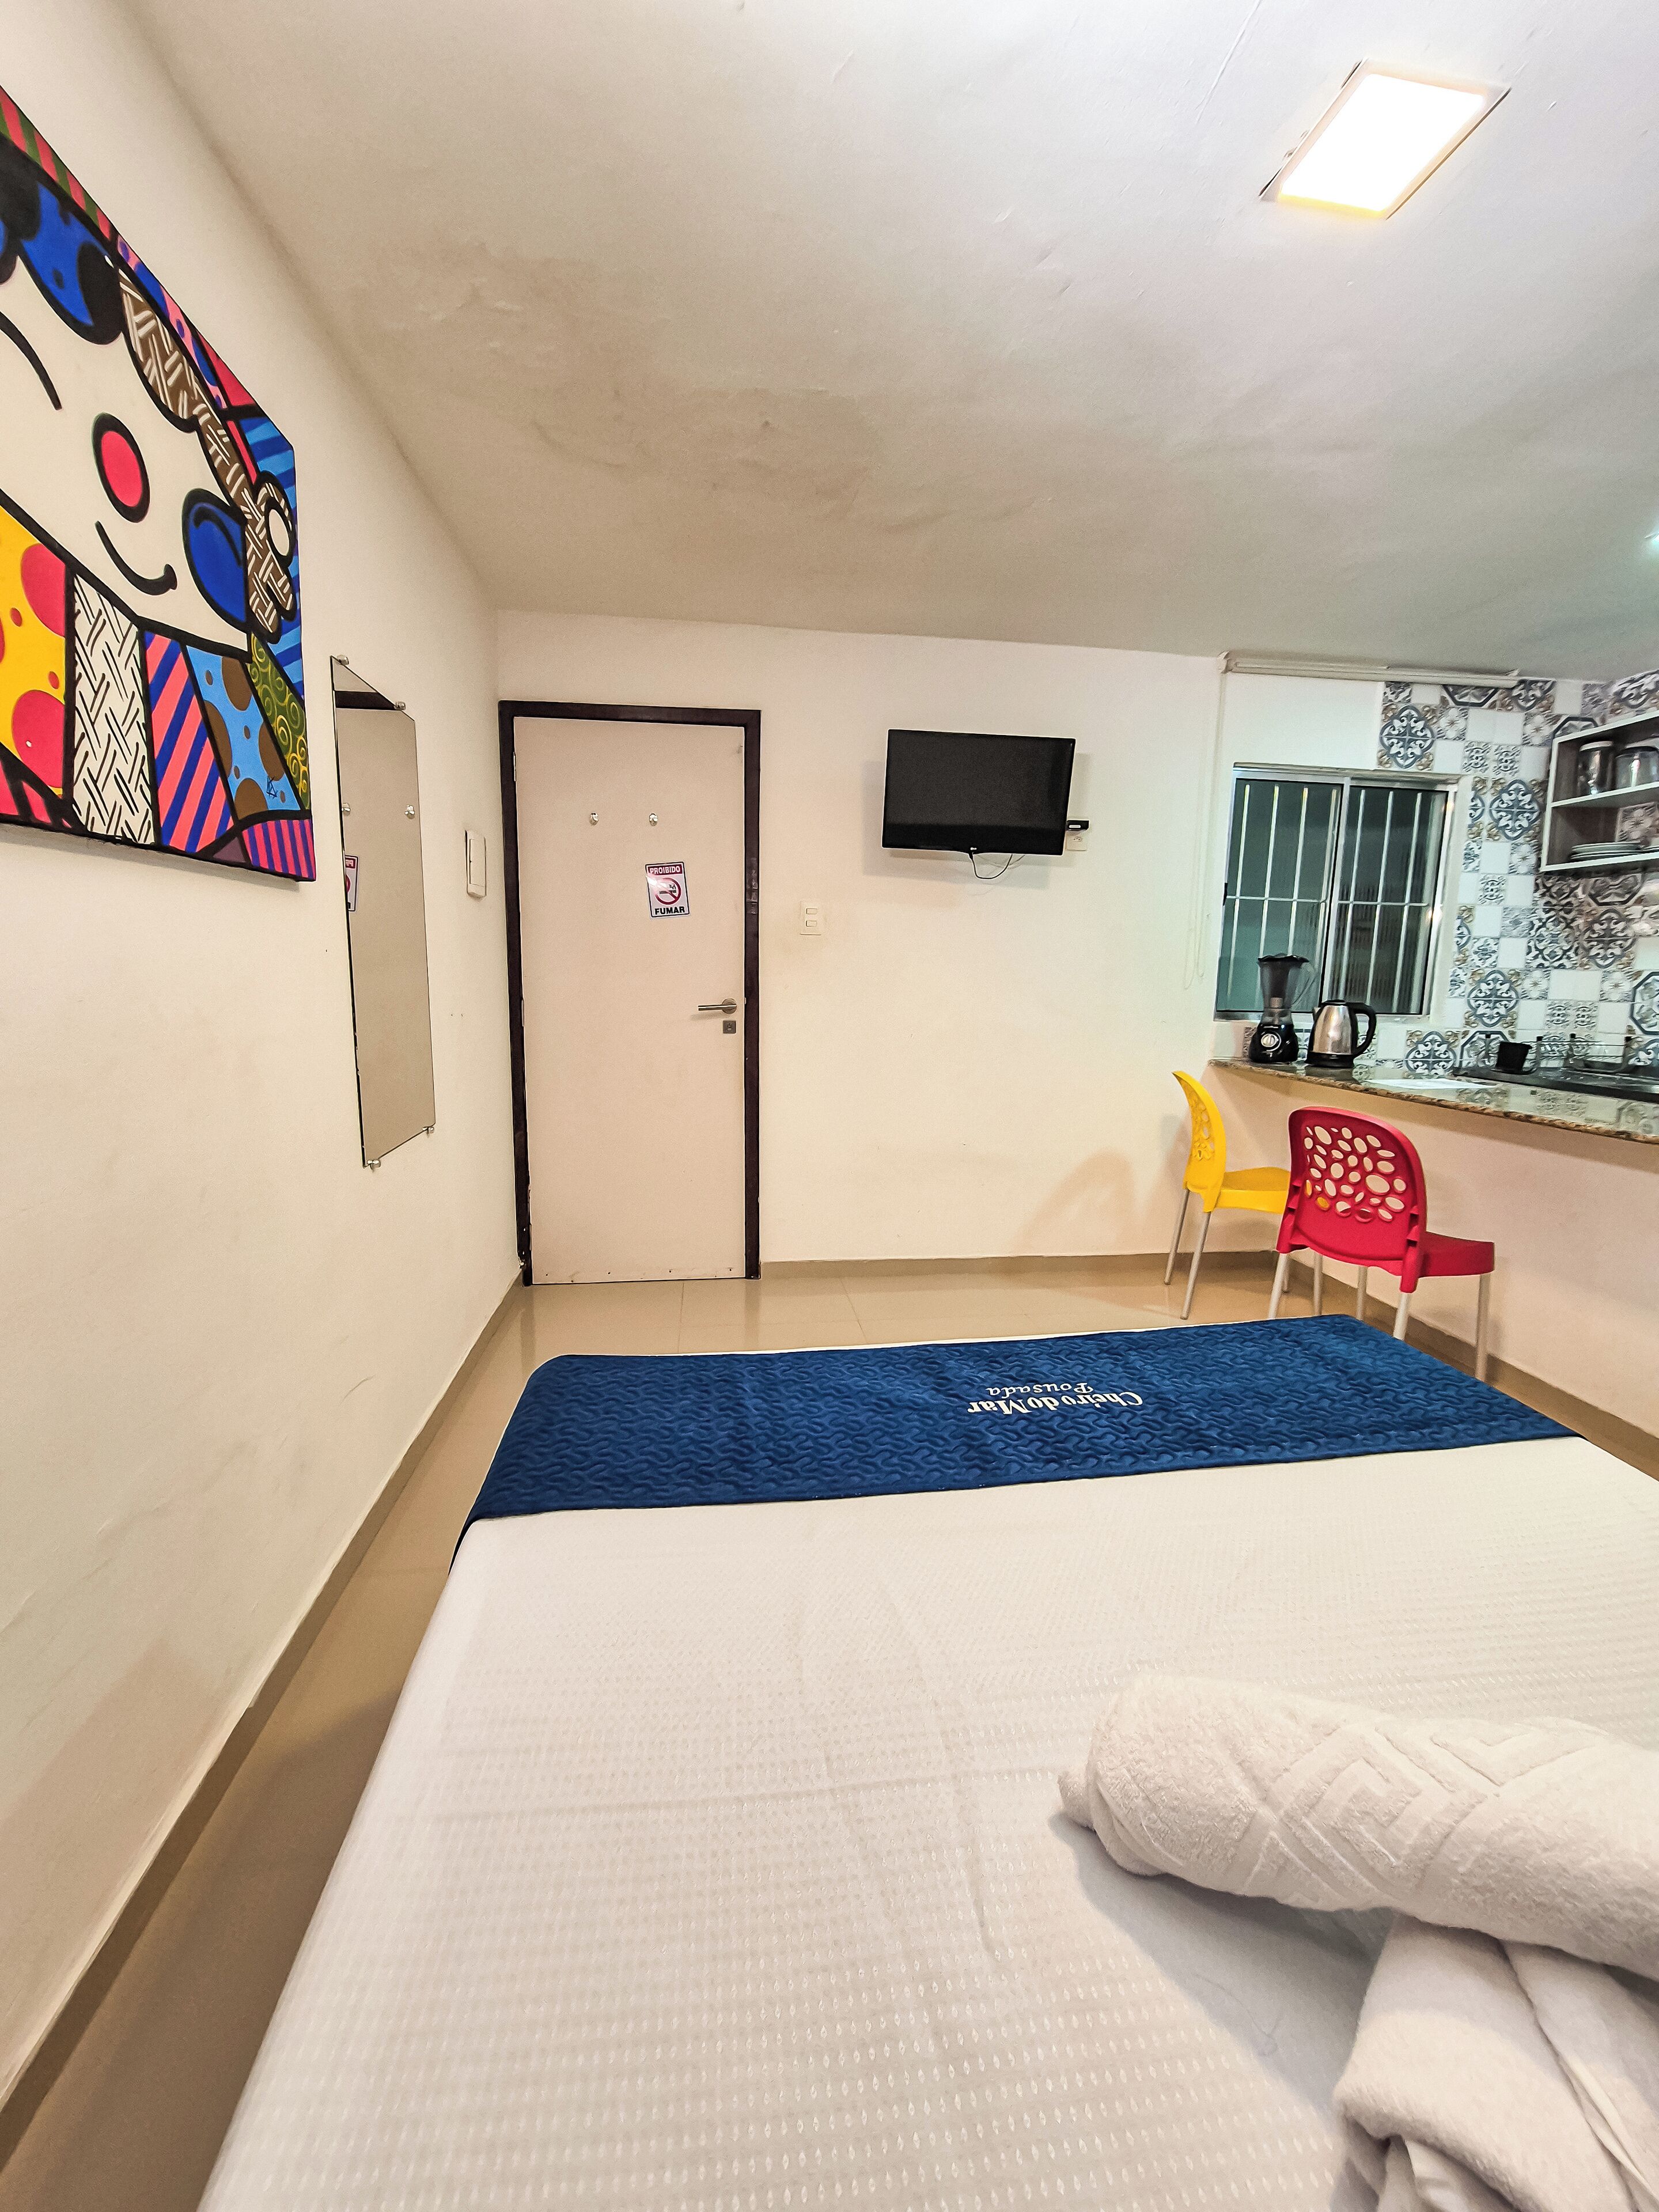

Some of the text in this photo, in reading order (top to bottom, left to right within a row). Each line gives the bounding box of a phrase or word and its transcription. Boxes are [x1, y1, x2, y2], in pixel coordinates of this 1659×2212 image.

[650, 866, 680, 874] PROIBIDO
[654, 906, 685, 915] FUMAR
[986, 1382, 1094, 1399] Pousada
[967, 1392, 1143, 1415] Cheiro do Mar
